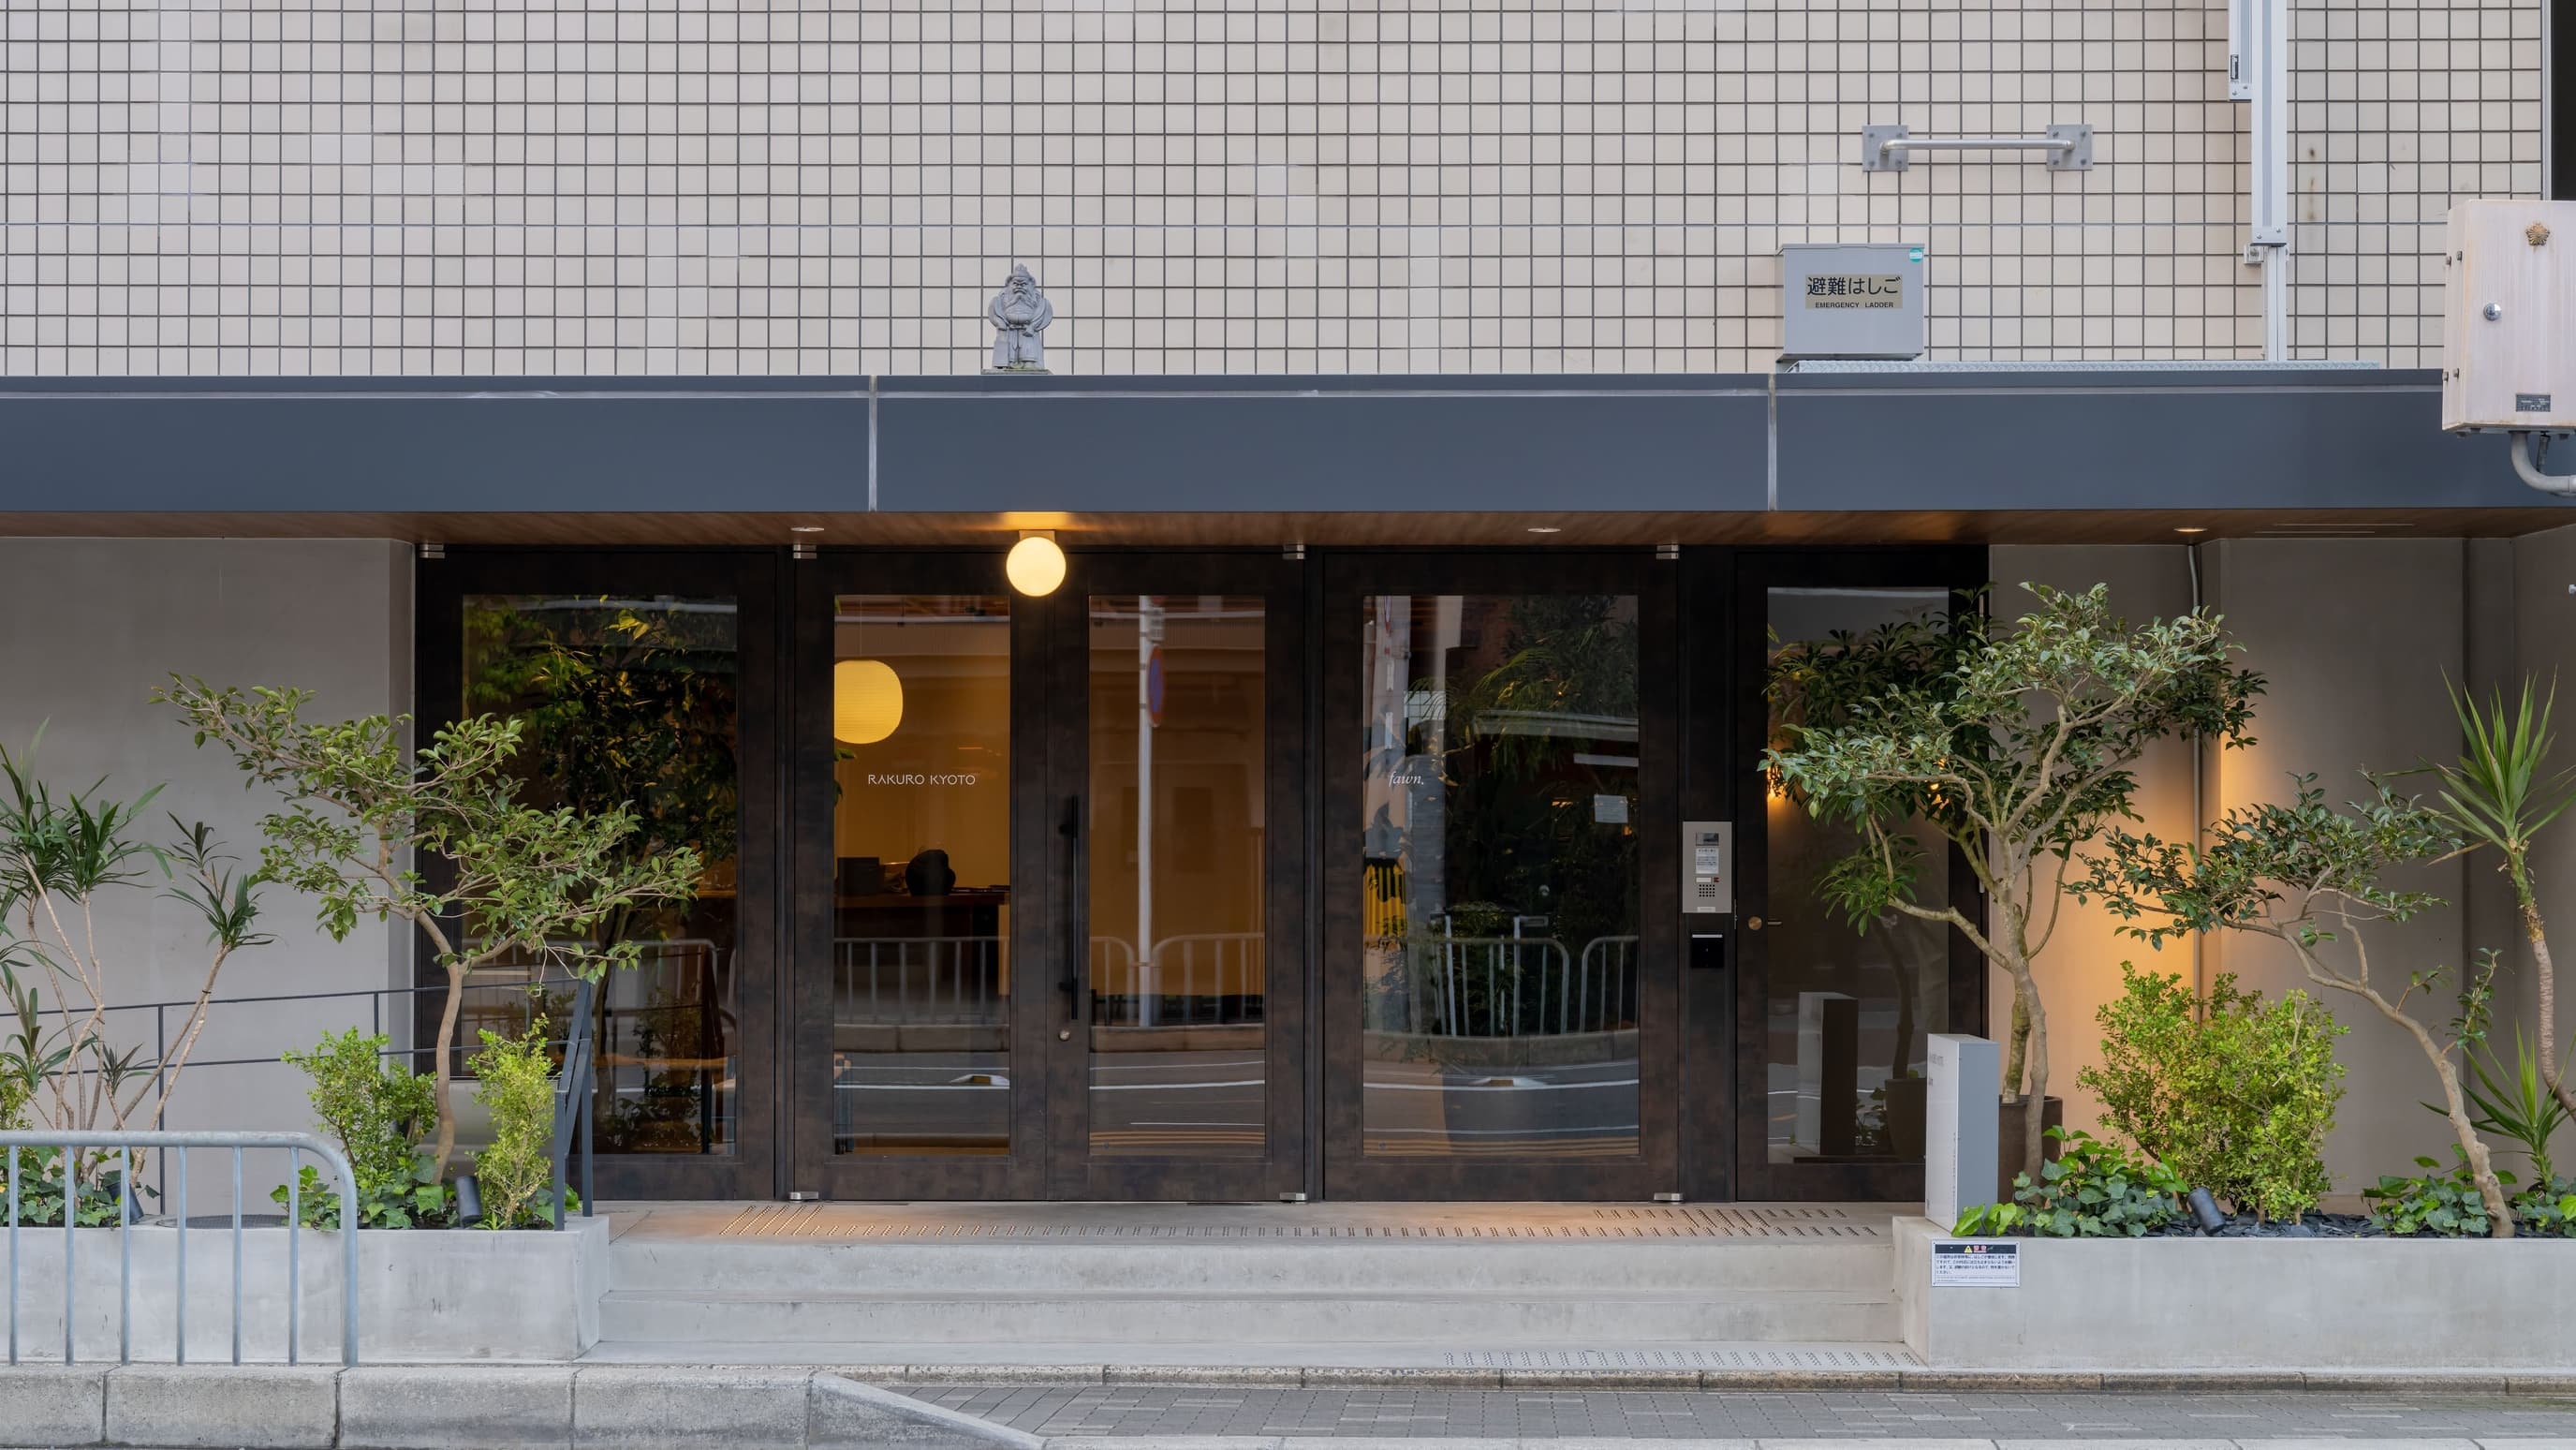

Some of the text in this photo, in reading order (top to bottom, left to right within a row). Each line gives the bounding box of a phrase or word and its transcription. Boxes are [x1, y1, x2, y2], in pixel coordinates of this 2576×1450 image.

[1807, 276, 1901, 296] 避難はしご
[868, 774, 976, 785] RAKURO KYOTO
